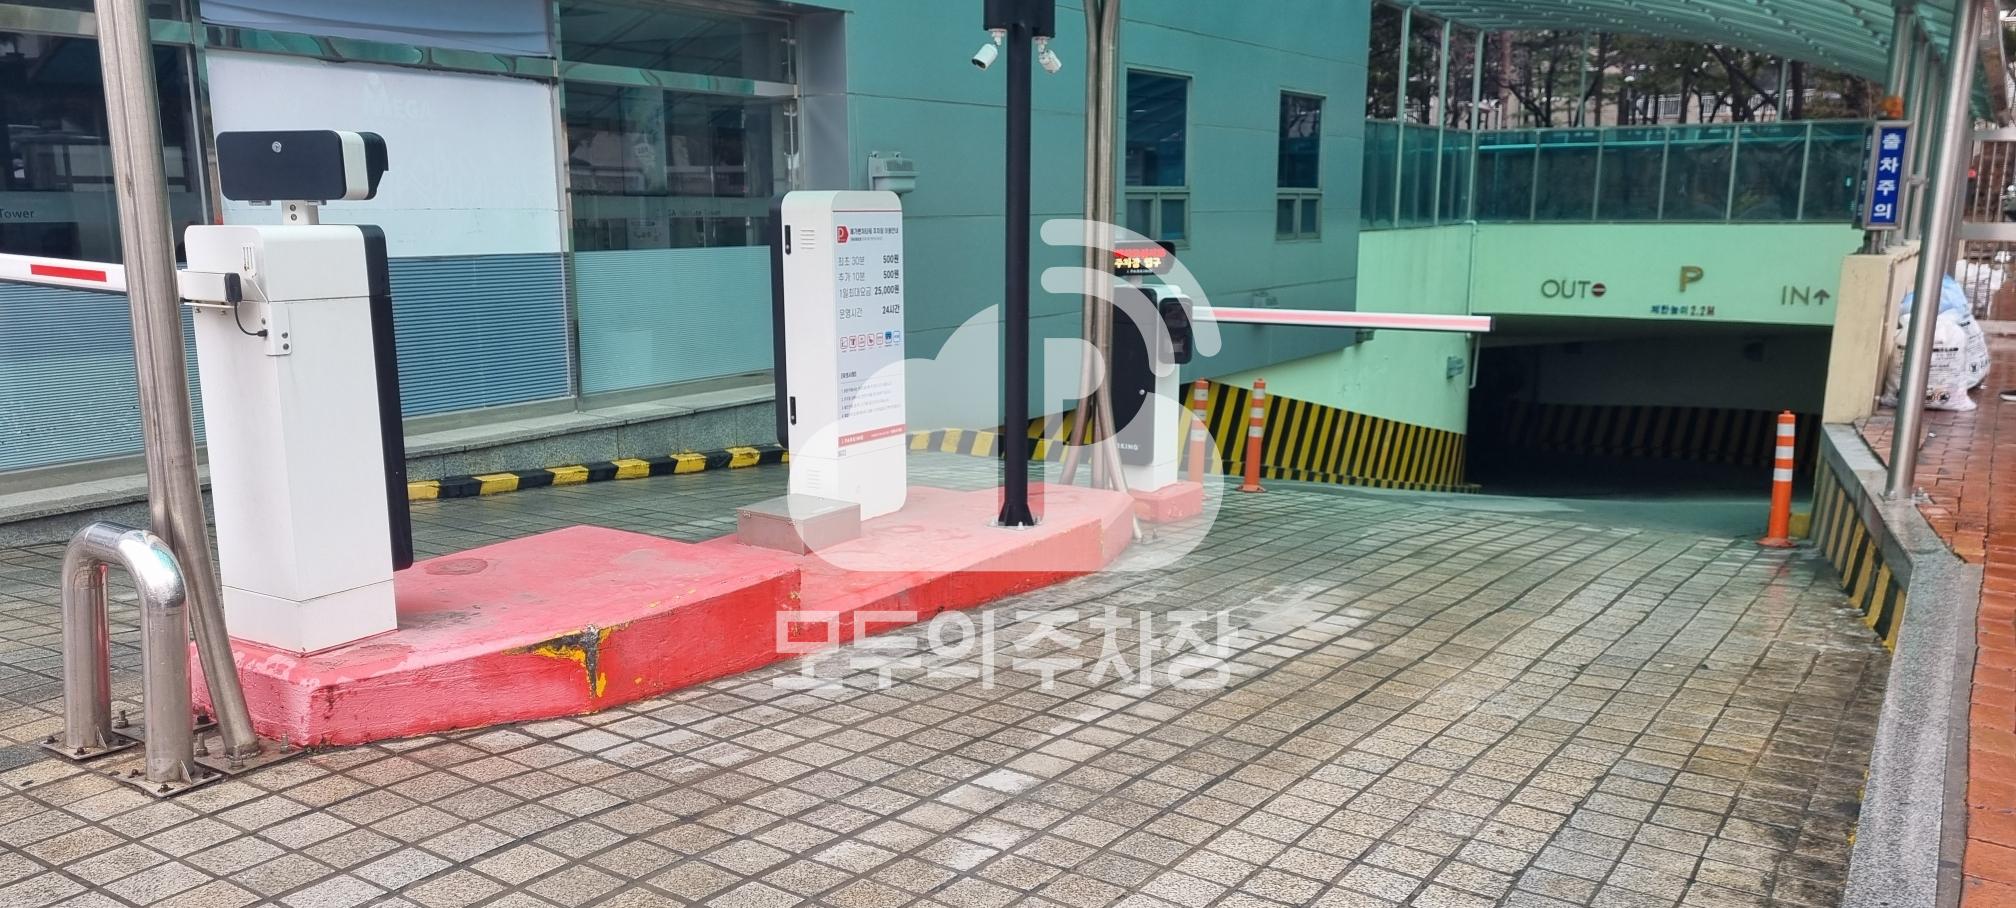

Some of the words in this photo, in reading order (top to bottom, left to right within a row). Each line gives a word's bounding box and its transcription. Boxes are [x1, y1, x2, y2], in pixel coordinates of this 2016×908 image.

[1873, 132, 1901, 219] 출차주의
[0, 208, 34, 218] Tower
[838, 257, 850, 266] 최초
[852, 256, 865, 265] 30분
[883, 254, 899, 264] 500원
[1114, 257, 1140, 269] 주차장
[839, 273, 851, 282] 추가
[853, 272, 865, 281] 10분
[883, 269, 899, 279] 500원
[1678, 265, 1703, 293] P
[839, 287, 872, 298] 1일최대요금
[874, 285, 900, 296] 25,000원
[1541, 279, 1591, 300] OUT
[1781, 285, 1810, 305] IN
[839, 308, 863, 319] 운영시간
[882, 304, 900, 315] 24시간
[1650, 304, 1688, 315] 제한높이
[1690, 305, 1715, 316] 2.2M
